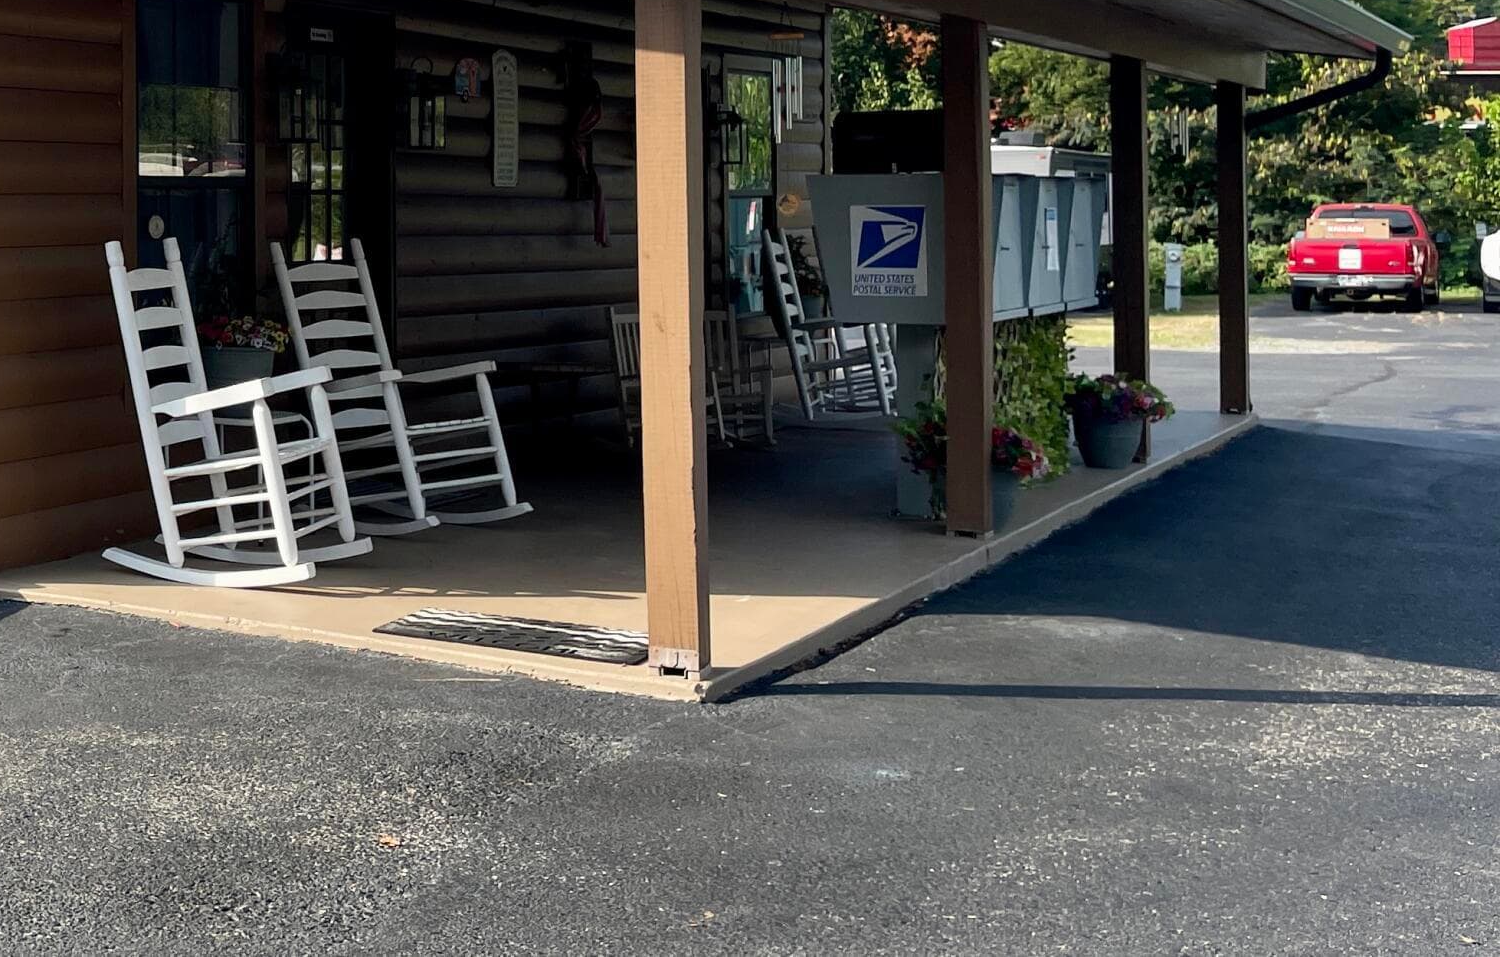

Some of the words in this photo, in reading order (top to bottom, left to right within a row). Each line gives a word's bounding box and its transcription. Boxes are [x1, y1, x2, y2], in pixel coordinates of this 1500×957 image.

[854, 273, 886, 283] UNITED
[886, 274, 915, 283] STATES
[853, 285, 882, 295] POSTAL
[884, 285, 917, 296] SERVICE
